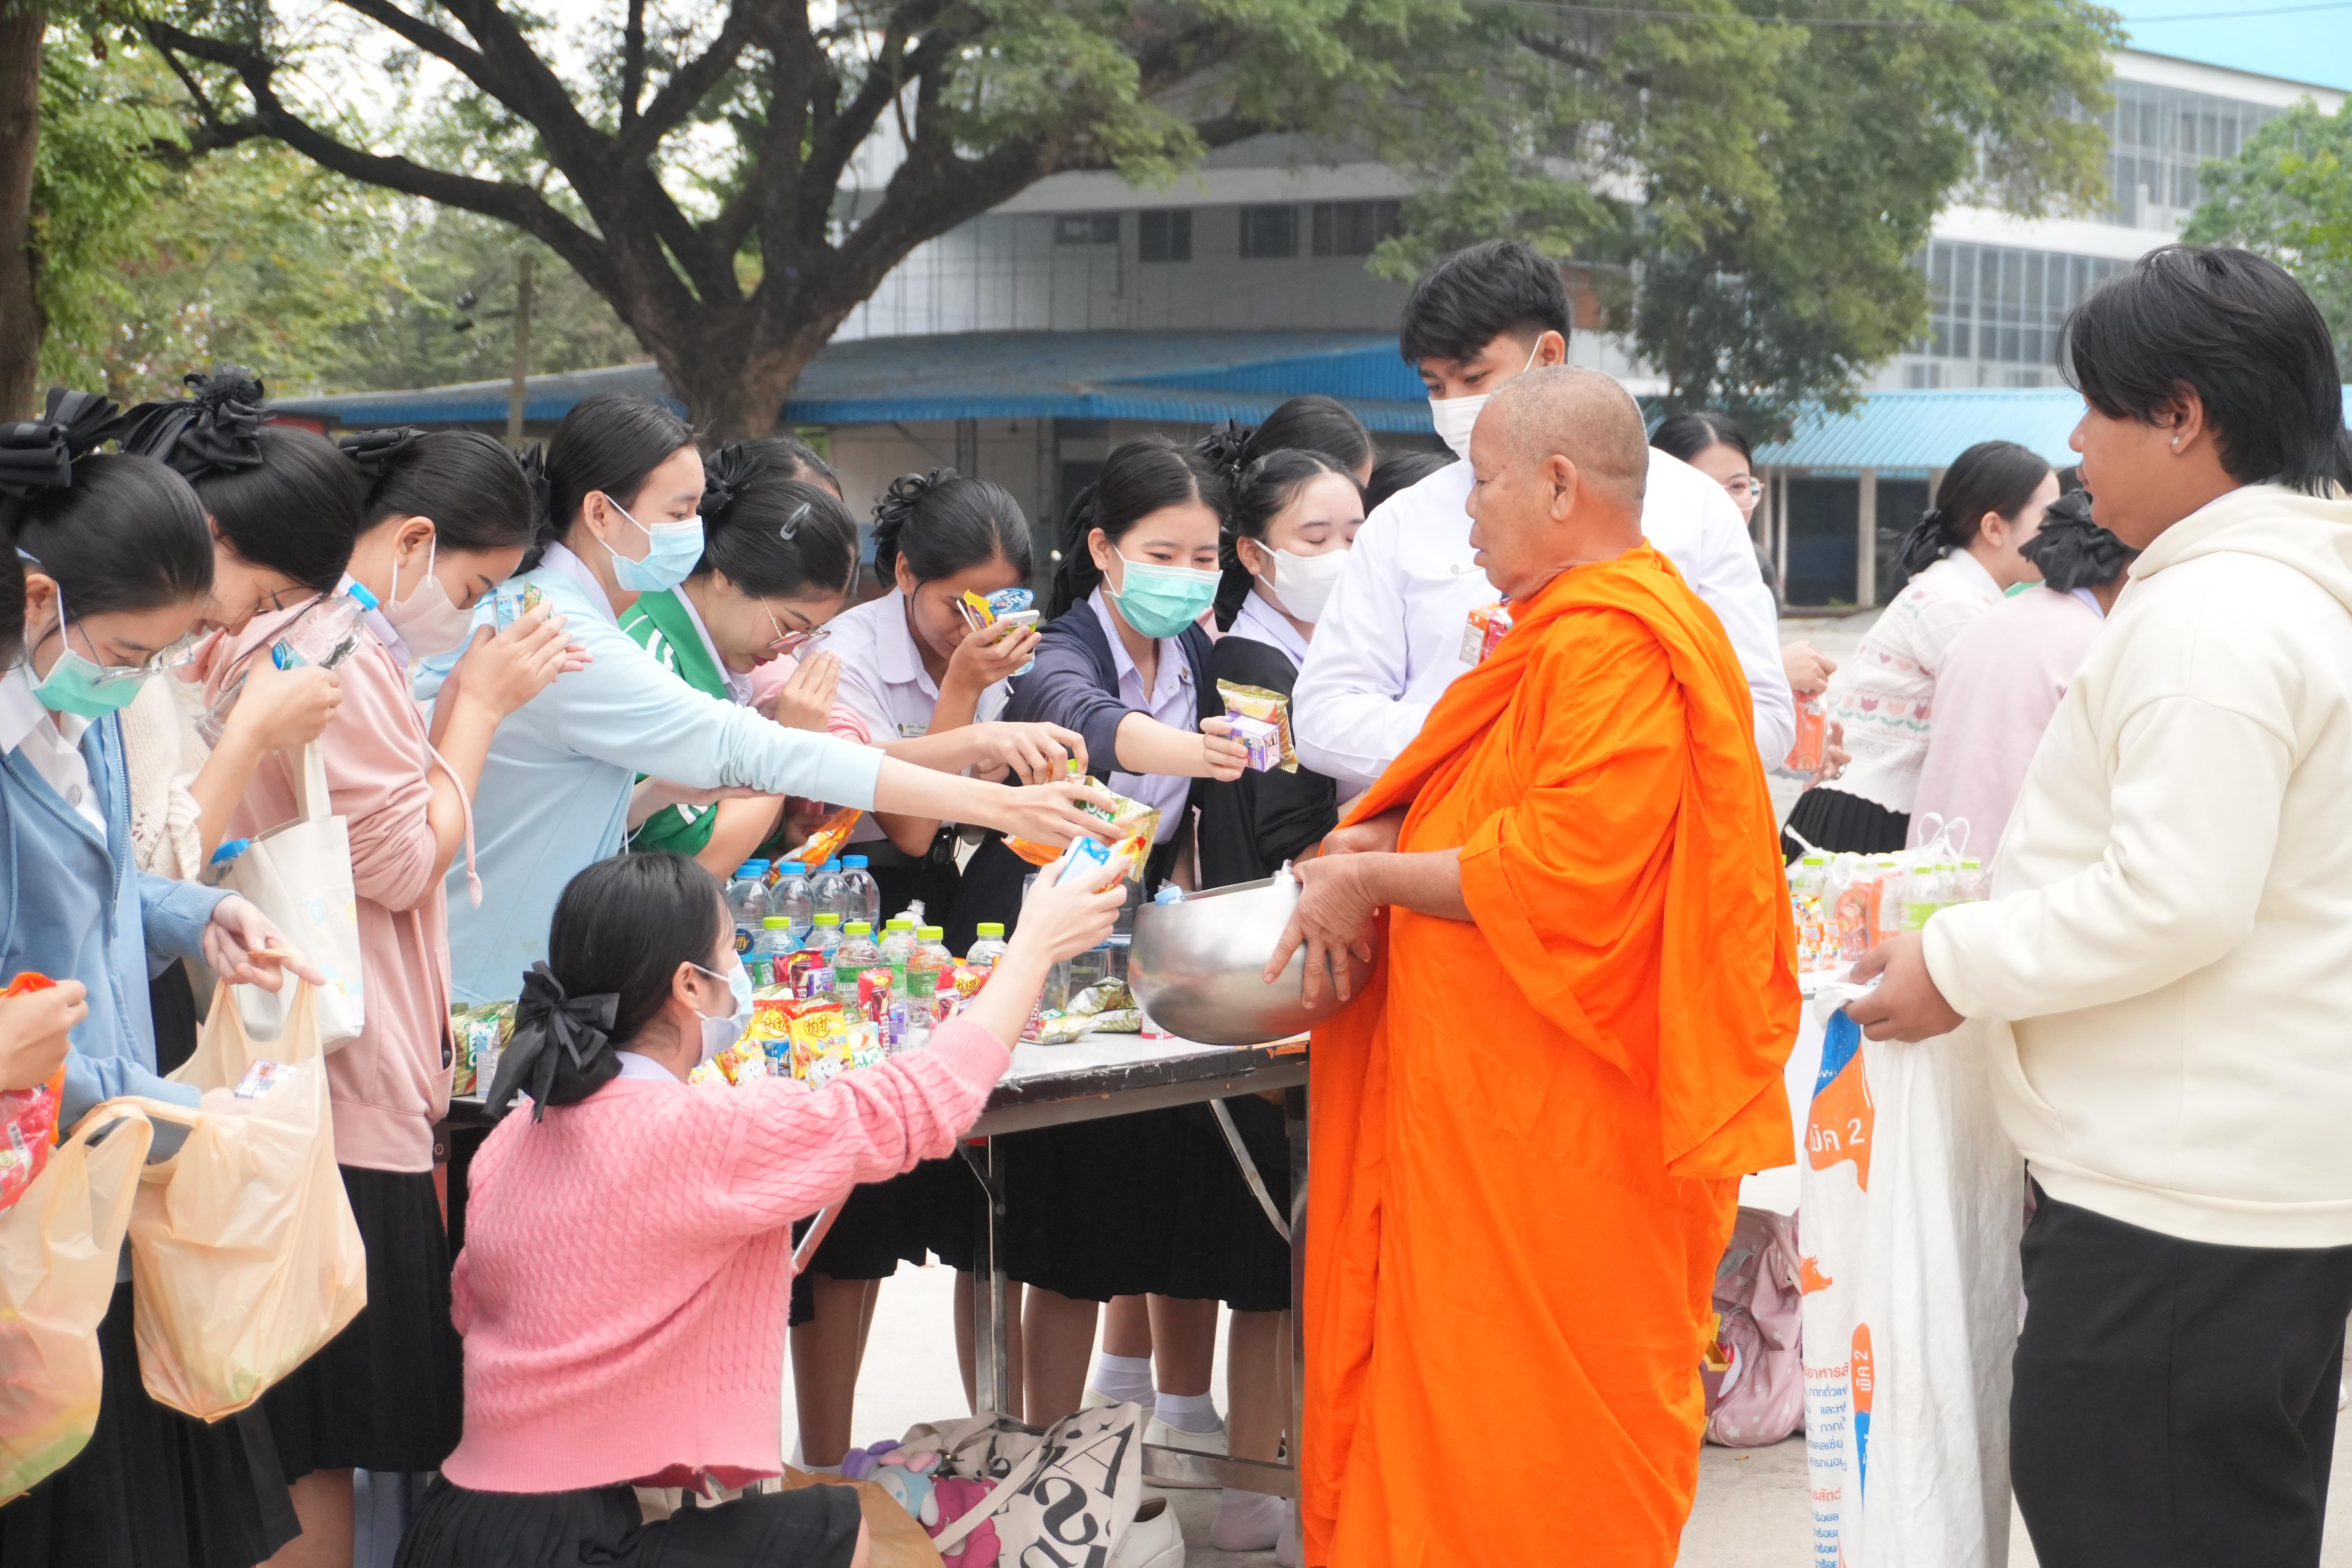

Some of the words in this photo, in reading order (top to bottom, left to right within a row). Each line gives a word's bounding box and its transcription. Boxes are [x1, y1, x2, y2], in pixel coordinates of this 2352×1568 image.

[803, 1014, 832, 1036] ยำยำ
[1847, 1118, 1865, 1146] 2
[1854, 1350, 1868, 1360] 2
